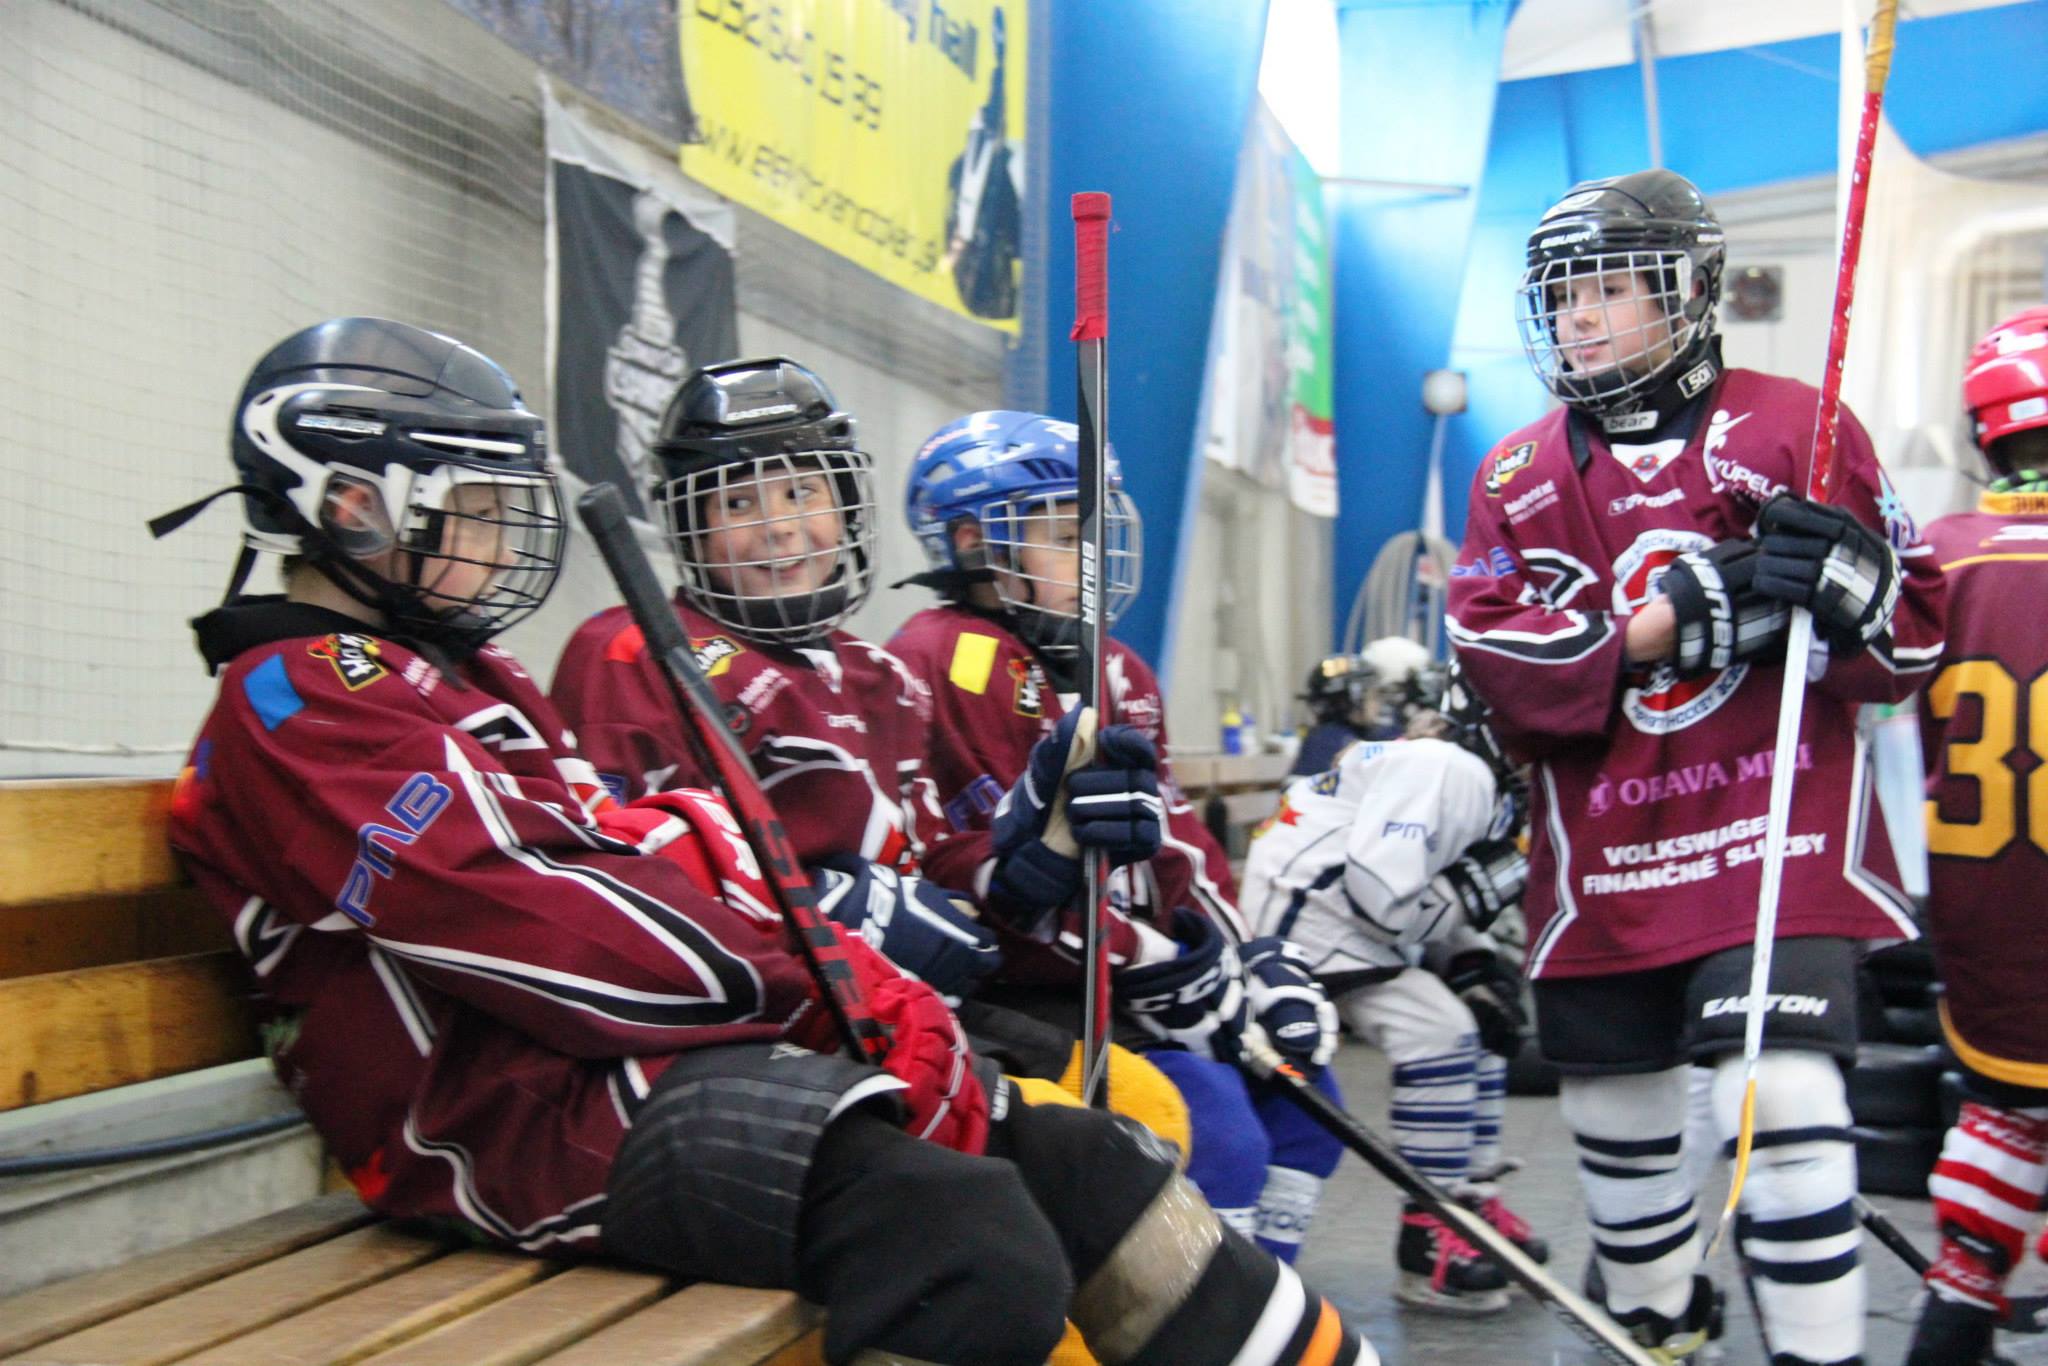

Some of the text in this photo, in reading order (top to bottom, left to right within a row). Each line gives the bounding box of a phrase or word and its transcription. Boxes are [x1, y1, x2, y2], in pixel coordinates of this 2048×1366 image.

[1081, 540, 1096, 625] BAUER
[336, 772, 454, 928] PMB
[1583, 853, 1719, 895] FINANČNÉ
[1603, 814, 1770, 867] VOLKSWAGE
